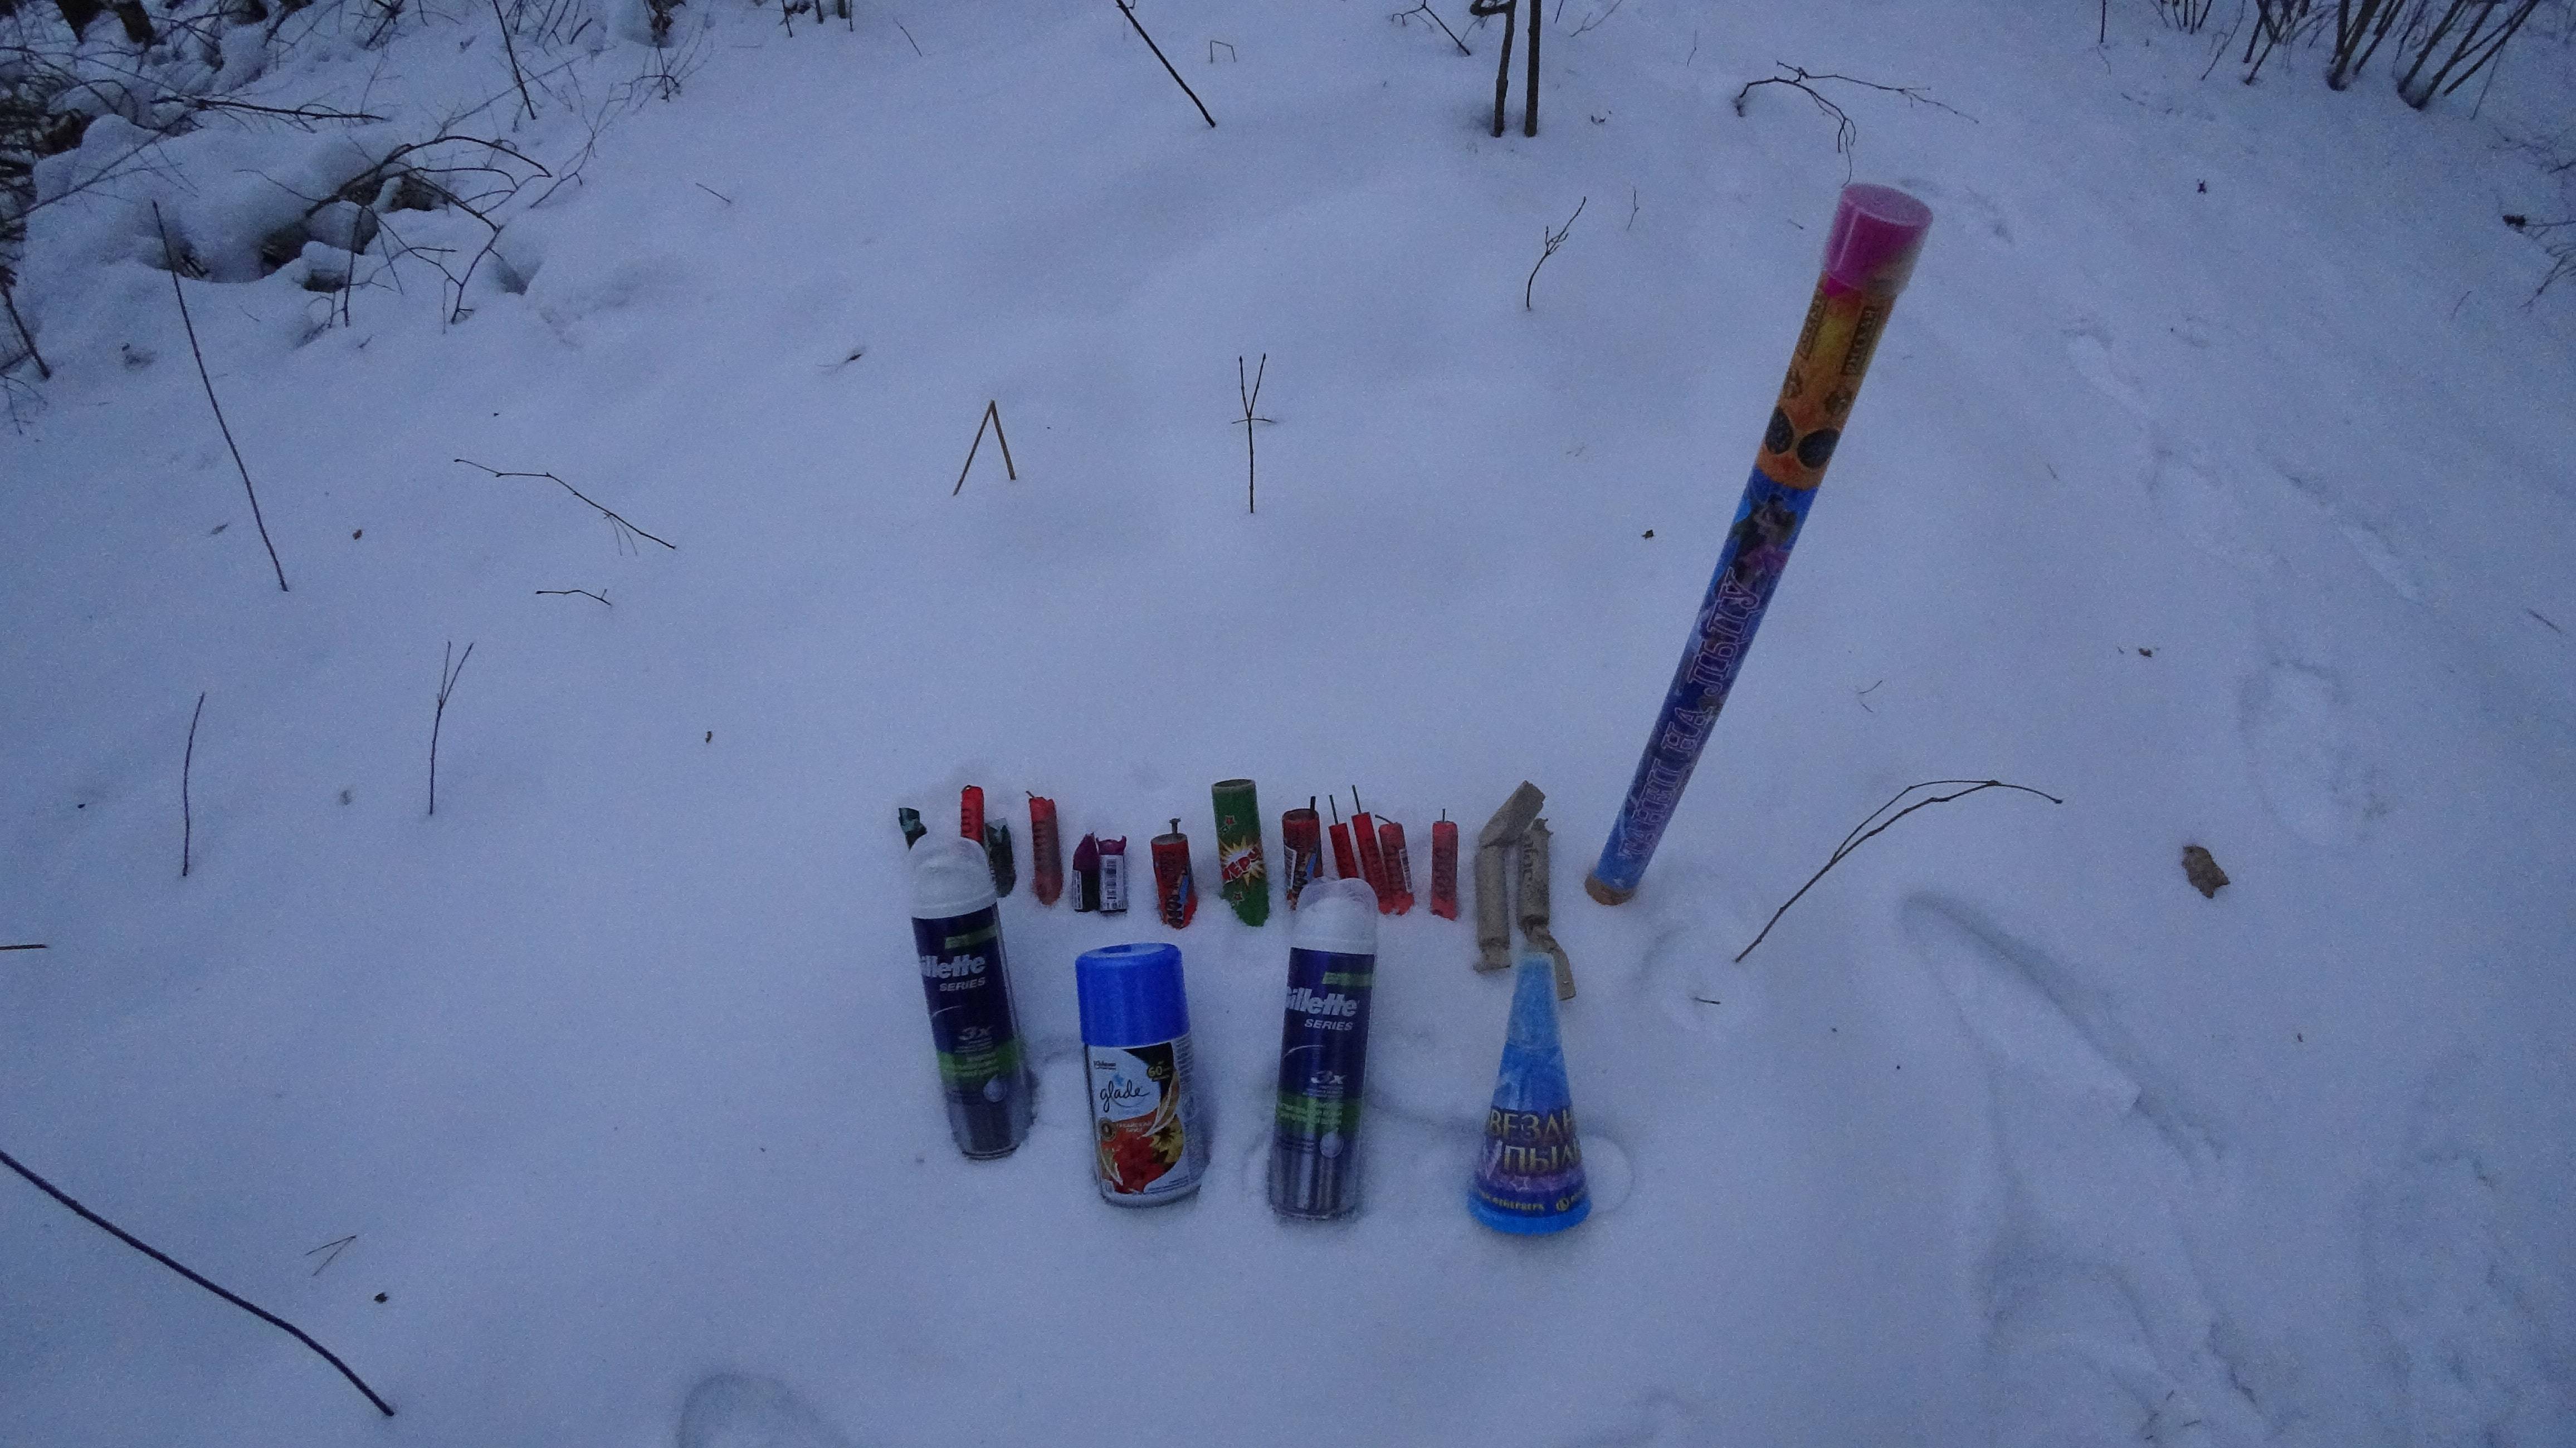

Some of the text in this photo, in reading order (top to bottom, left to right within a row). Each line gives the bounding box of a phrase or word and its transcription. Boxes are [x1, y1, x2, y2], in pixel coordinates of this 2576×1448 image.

[1687, 567, 1760, 697] ЛЬДУ
[1661, 706, 1715, 757] НА
[920, 955, 987, 979] illette
[939, 977, 986, 992] SERIES
[1304, 1019, 1354, 1031] SERIES
[1148, 1065, 1163, 1077] 60
[1100, 1079, 1150, 1113] glade
[1488, 1108, 1573, 1141] ВЕЗДН
